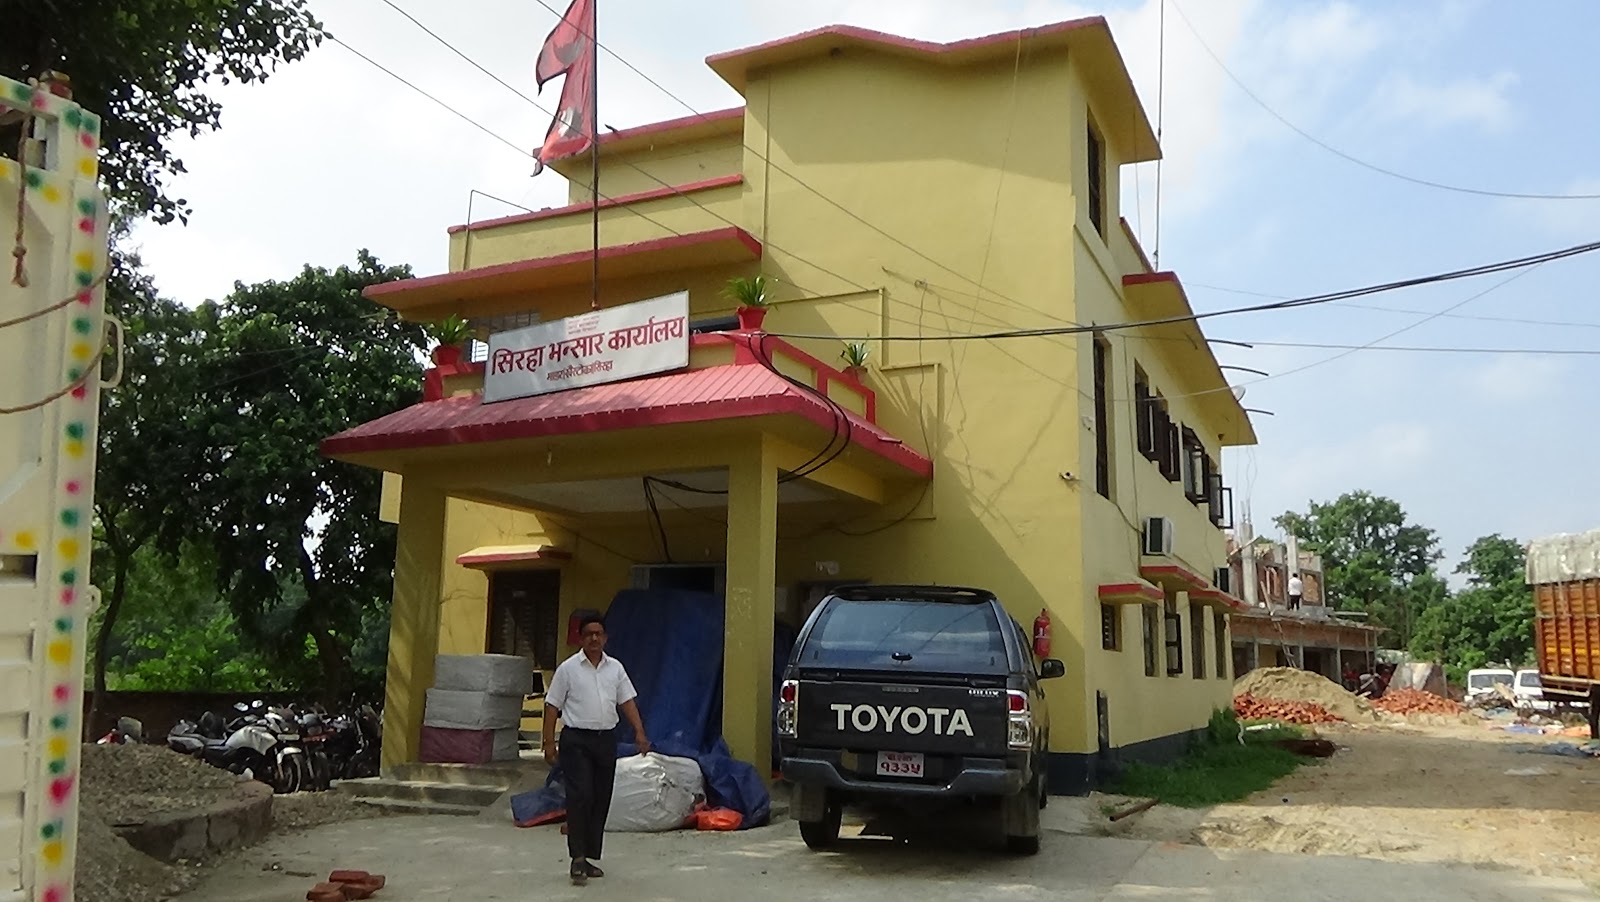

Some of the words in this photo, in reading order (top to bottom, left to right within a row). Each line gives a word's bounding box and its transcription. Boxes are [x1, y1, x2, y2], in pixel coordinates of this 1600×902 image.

[491, 344, 546, 375] सिरहा
[548, 332, 605, 363] भन्सार
[608, 316, 685, 351] कार्यालय
[830, 703, 974, 737] TOYOTA
